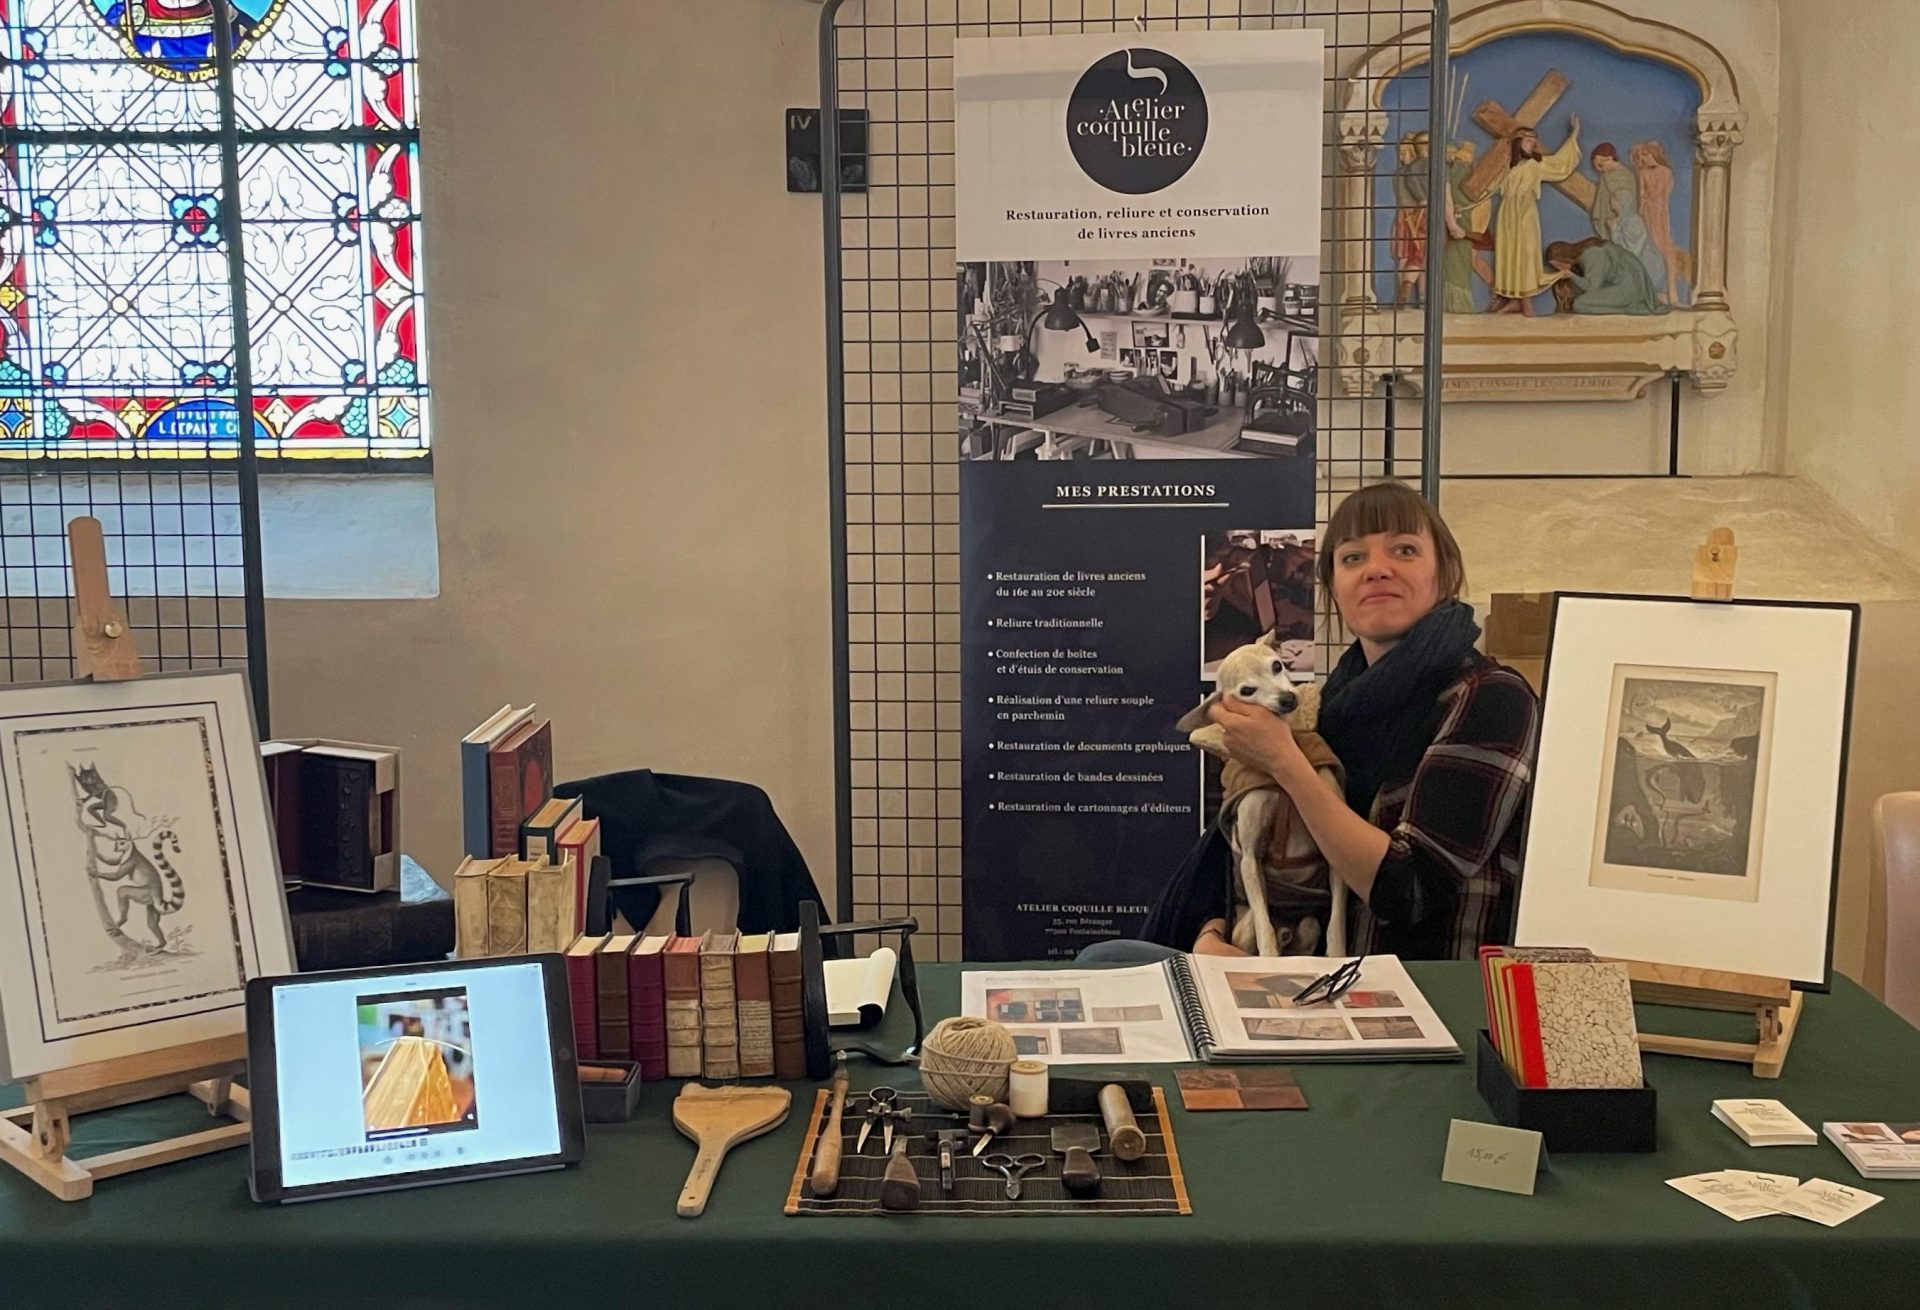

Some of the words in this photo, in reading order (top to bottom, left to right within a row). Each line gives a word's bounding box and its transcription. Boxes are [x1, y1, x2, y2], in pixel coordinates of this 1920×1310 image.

[791, 115, 812, 130] IV
[1077, 121, 1171, 142] coquille
[1006, 208, 1102, 221] Restauration,
[1106, 207, 1155, 219] reliure
[1159, 208, 1172, 218] et
[1176, 204, 1269, 218] conservation
[1077, 228, 1095, 239] de
[1099, 228, 1138, 239] livres
[1142, 227, 1196, 239] anciens
[1056, 486, 1092, 498] MES
[1097, 484, 1216, 498] PRESTATIONS
[995, 571, 1060, 581] Restauration
[1062, 571, 1075, 581] de
[1077, 570, 1105, 581] livres
[1107, 571, 1147, 581] anciens
[996, 587, 1010, 597] du
[1012, 587, 1029, 597] 16e
[1031, 588, 1044, 597] au
[1046, 588, 1065, 597] 20e
[1067, 586, 1096, 597] siècle
[996, 617, 1033, 628] Reliure
[1035, 617, 1104, 628] traditionnelle
[995, 648, 1050, 659] Confection
[1052, 648, 1065, 659] de
[996, 664, 1007, 674] et
[1044, 664, 1057, 674] de
[1059, 664, 1124, 675] conservation
[997, 694, 1052, 705] Réalisation
[1085, 695, 1119, 705] reliure
[1121, 694, 1155, 707] souple
[997, 711, 1010, 720] en
[1012, 710, 1065, 722] parchemin
[997, 741, 1061, 751] Restauration
[1063, 741, 1076, 751] de
[1077, 741, 1133, 751] documents
[1135, 741, 1191, 753] graphiques
[997, 771, 1061, 782] Restauration
[1063, 771, 1076, 782] de
[1078, 771, 1114, 782] bandes
[1115, 770, 1164, 782] dessinées
[998, 801, 1062, 812] Restauration
[1064, 802, 1076, 812] de
[1078, 802, 1139, 815] cartonnages
[1141, 801, 1192, 813] d'éditeurs
[1016, 903, 1060, 912] ATELIER
[1061, 904, 1113, 914] COQUILLE
[1116, 904, 1150, 914] BLEUE
